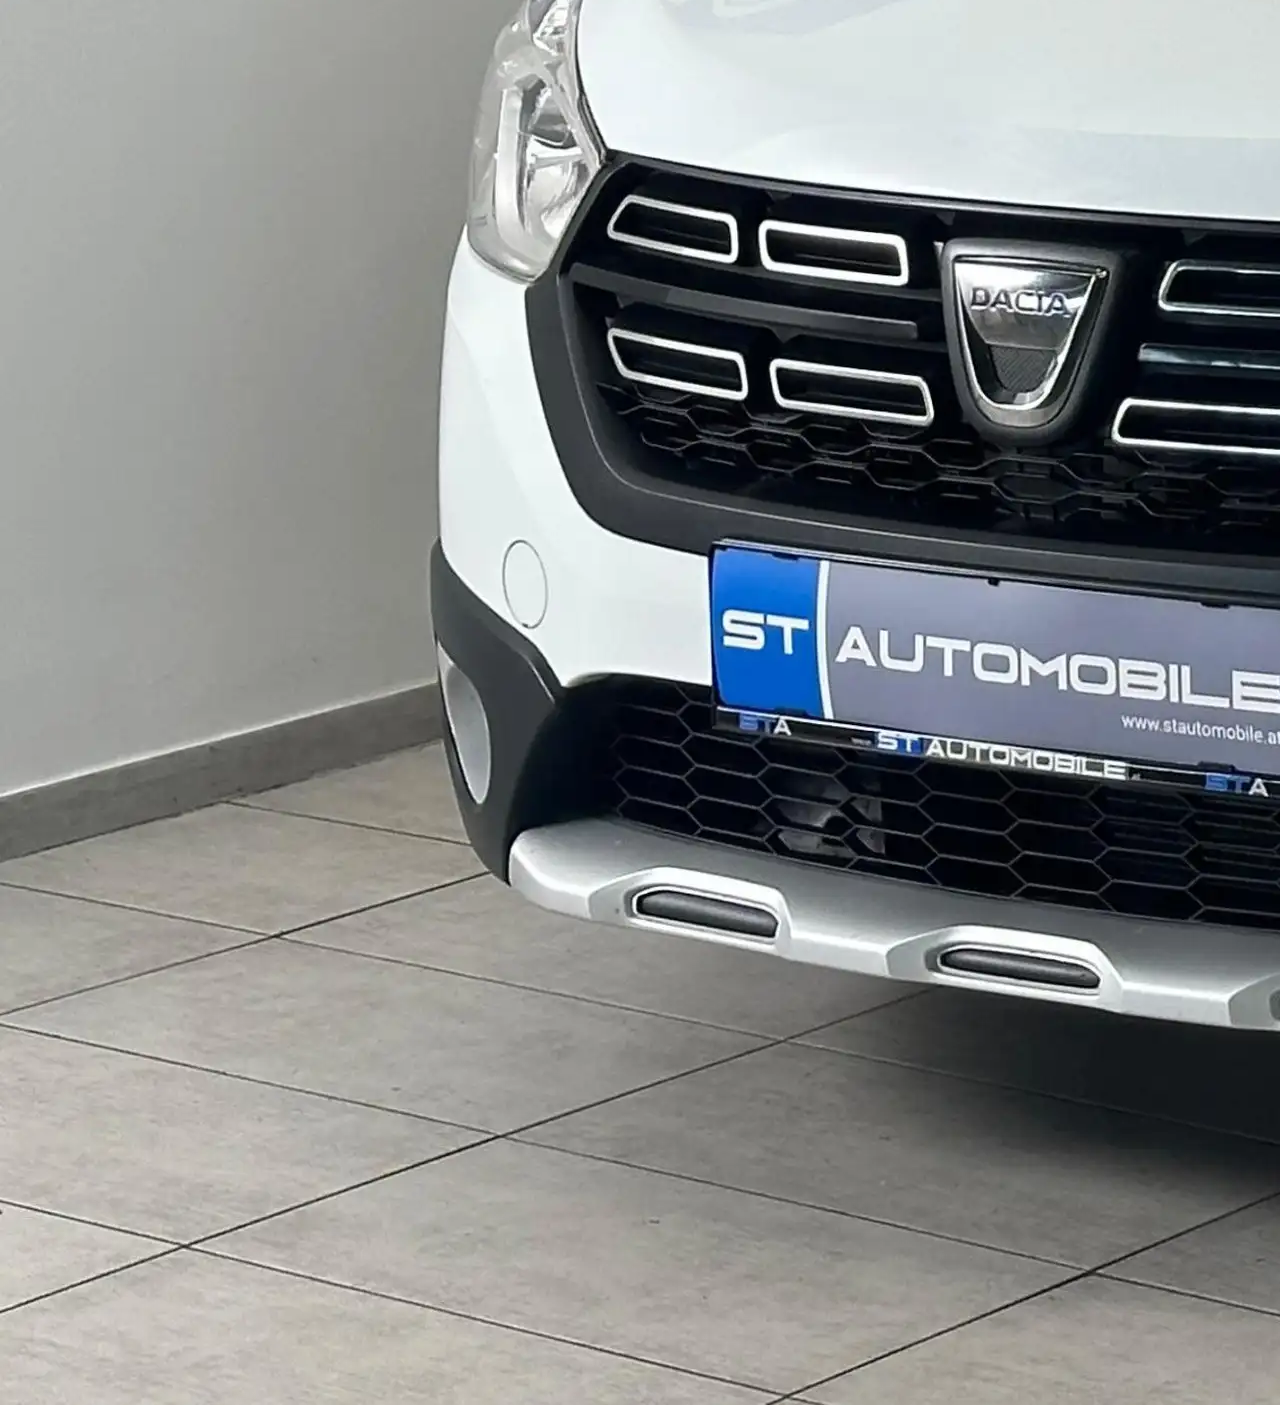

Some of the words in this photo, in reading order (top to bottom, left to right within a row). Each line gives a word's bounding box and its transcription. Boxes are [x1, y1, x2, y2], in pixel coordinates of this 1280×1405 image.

[970, 287, 1072, 318] DACIA
[722, 608, 809, 656] ST
[876, 730, 921, 753] ST
[926, 738, 1127, 780] AUTOMOBILE
[1204, 772, 1270, 798] STA
